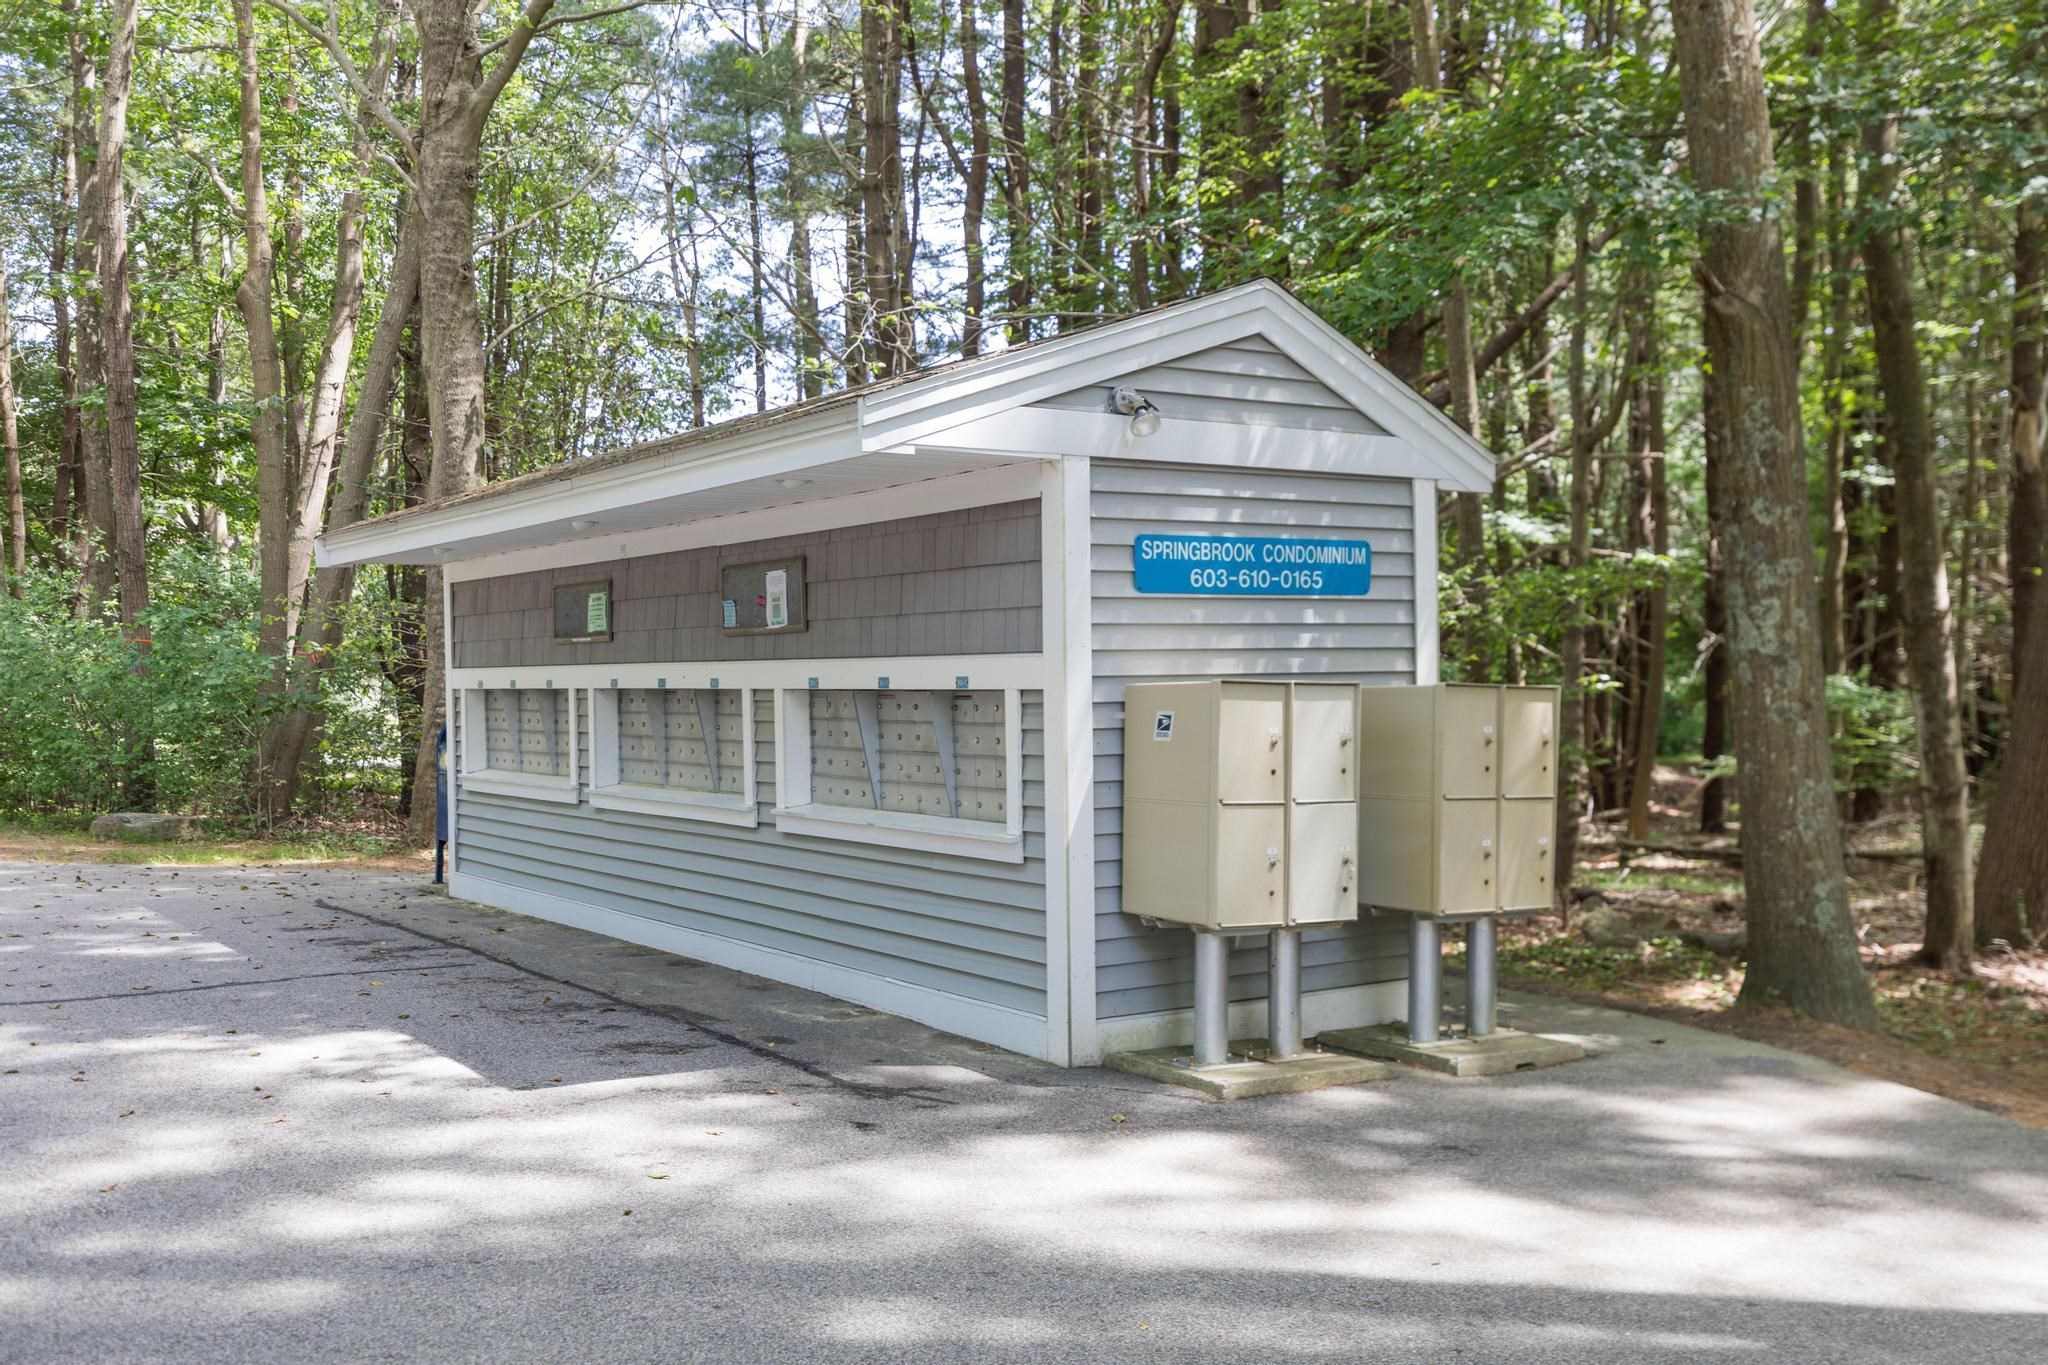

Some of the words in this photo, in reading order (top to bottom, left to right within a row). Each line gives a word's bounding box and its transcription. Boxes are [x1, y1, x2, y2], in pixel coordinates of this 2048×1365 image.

[1141, 540, 1256, 562] SPRINGBROOK
[1263, 543, 1367, 565] CONDOMINIUM
[1190, 569, 1323, 589] 603-610-0165
